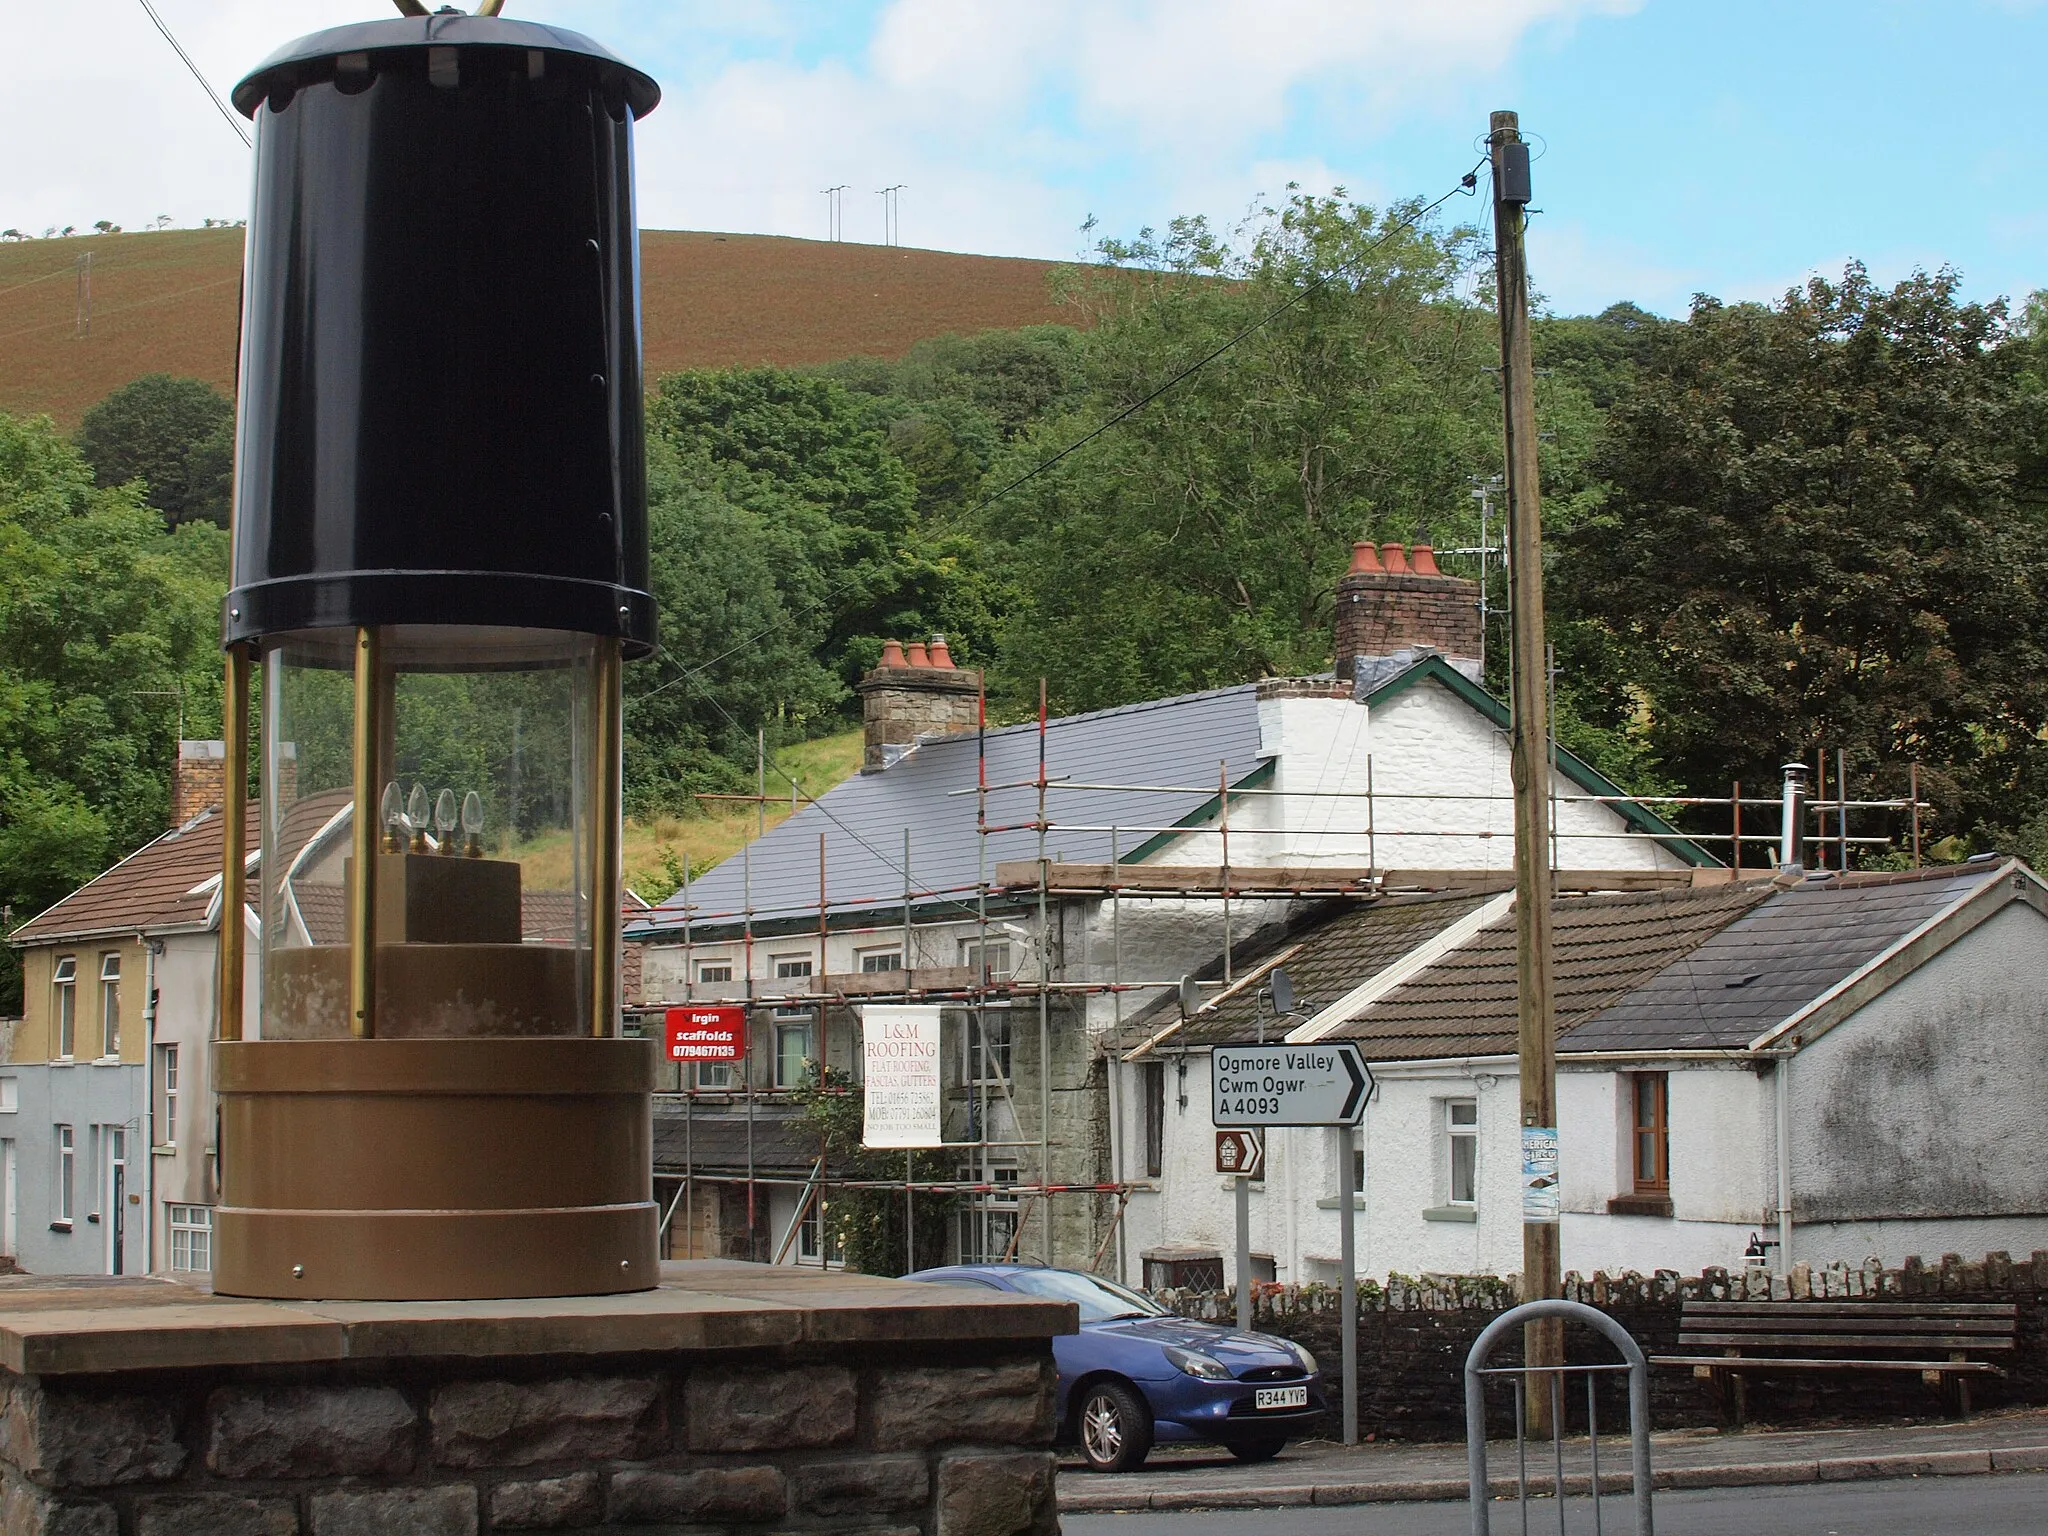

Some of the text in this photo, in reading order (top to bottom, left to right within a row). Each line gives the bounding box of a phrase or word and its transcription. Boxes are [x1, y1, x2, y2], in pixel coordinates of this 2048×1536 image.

[676, 1030, 733, 1041] scaffolds
[883, 1023, 919, 1039] L&M
[673, 1045, 735, 1057] 07794677135
[867, 1041, 936, 1057] ROOFING
[872, 1061, 890, 1072] FLAT
[1218, 1053, 1334, 1074] Ogmore Valley
[901, 1075, 936, 1087] GUTTERS
[1219, 1076, 1305, 1095] Cwm Ogwr
[870, 1091, 887, 1105] TEL:
[888, 1092, 908, 1105] 01656
[1219, 1097, 1279, 1115] A 4093
[868, 1107, 888, 1120] MOB:
[1257, 1390, 1306, 1405] R344 YVR
